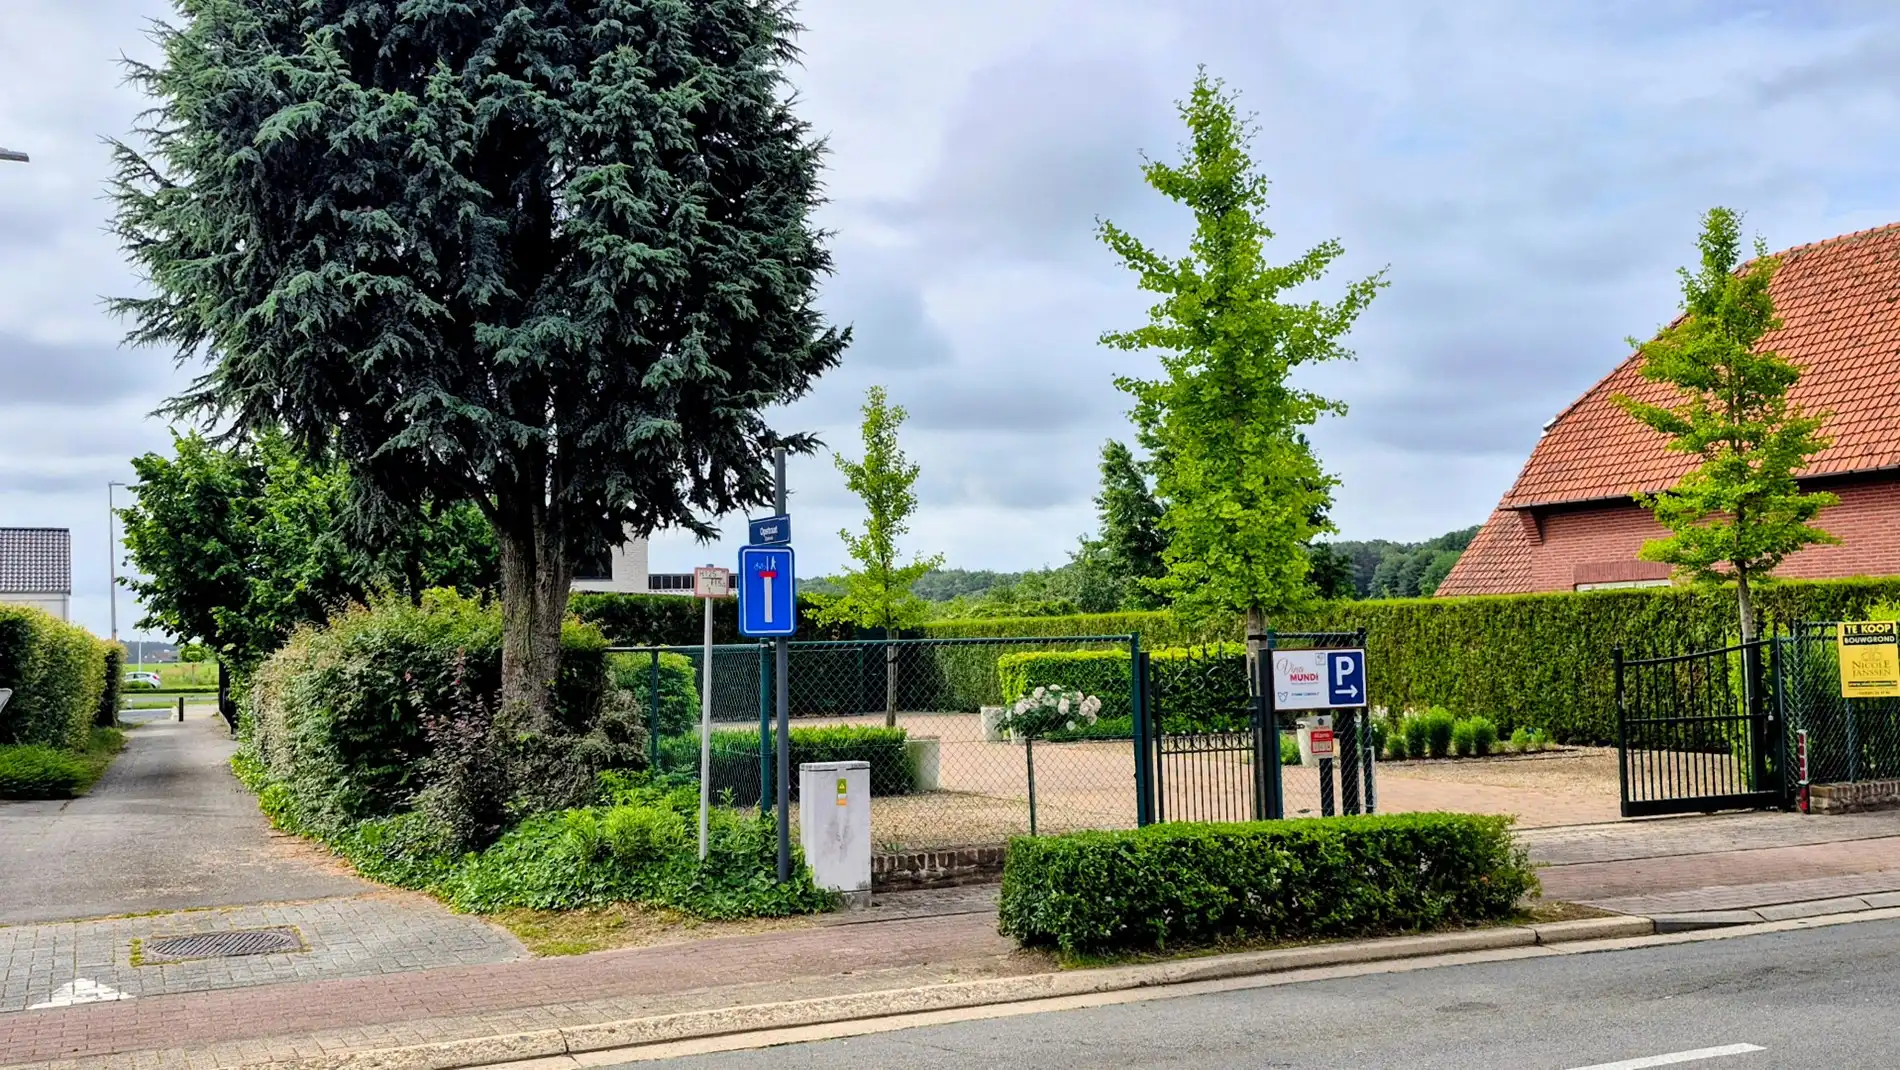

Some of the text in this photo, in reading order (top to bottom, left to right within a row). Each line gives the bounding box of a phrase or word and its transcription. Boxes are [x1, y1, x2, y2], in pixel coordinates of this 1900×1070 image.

[1846, 625, 1891, 634] TE KOOP
[1852, 660, 1892, 669] NICOLE
[1335, 656, 1355, 686] P
[1853, 669, 1891, 678] JANSSEN
